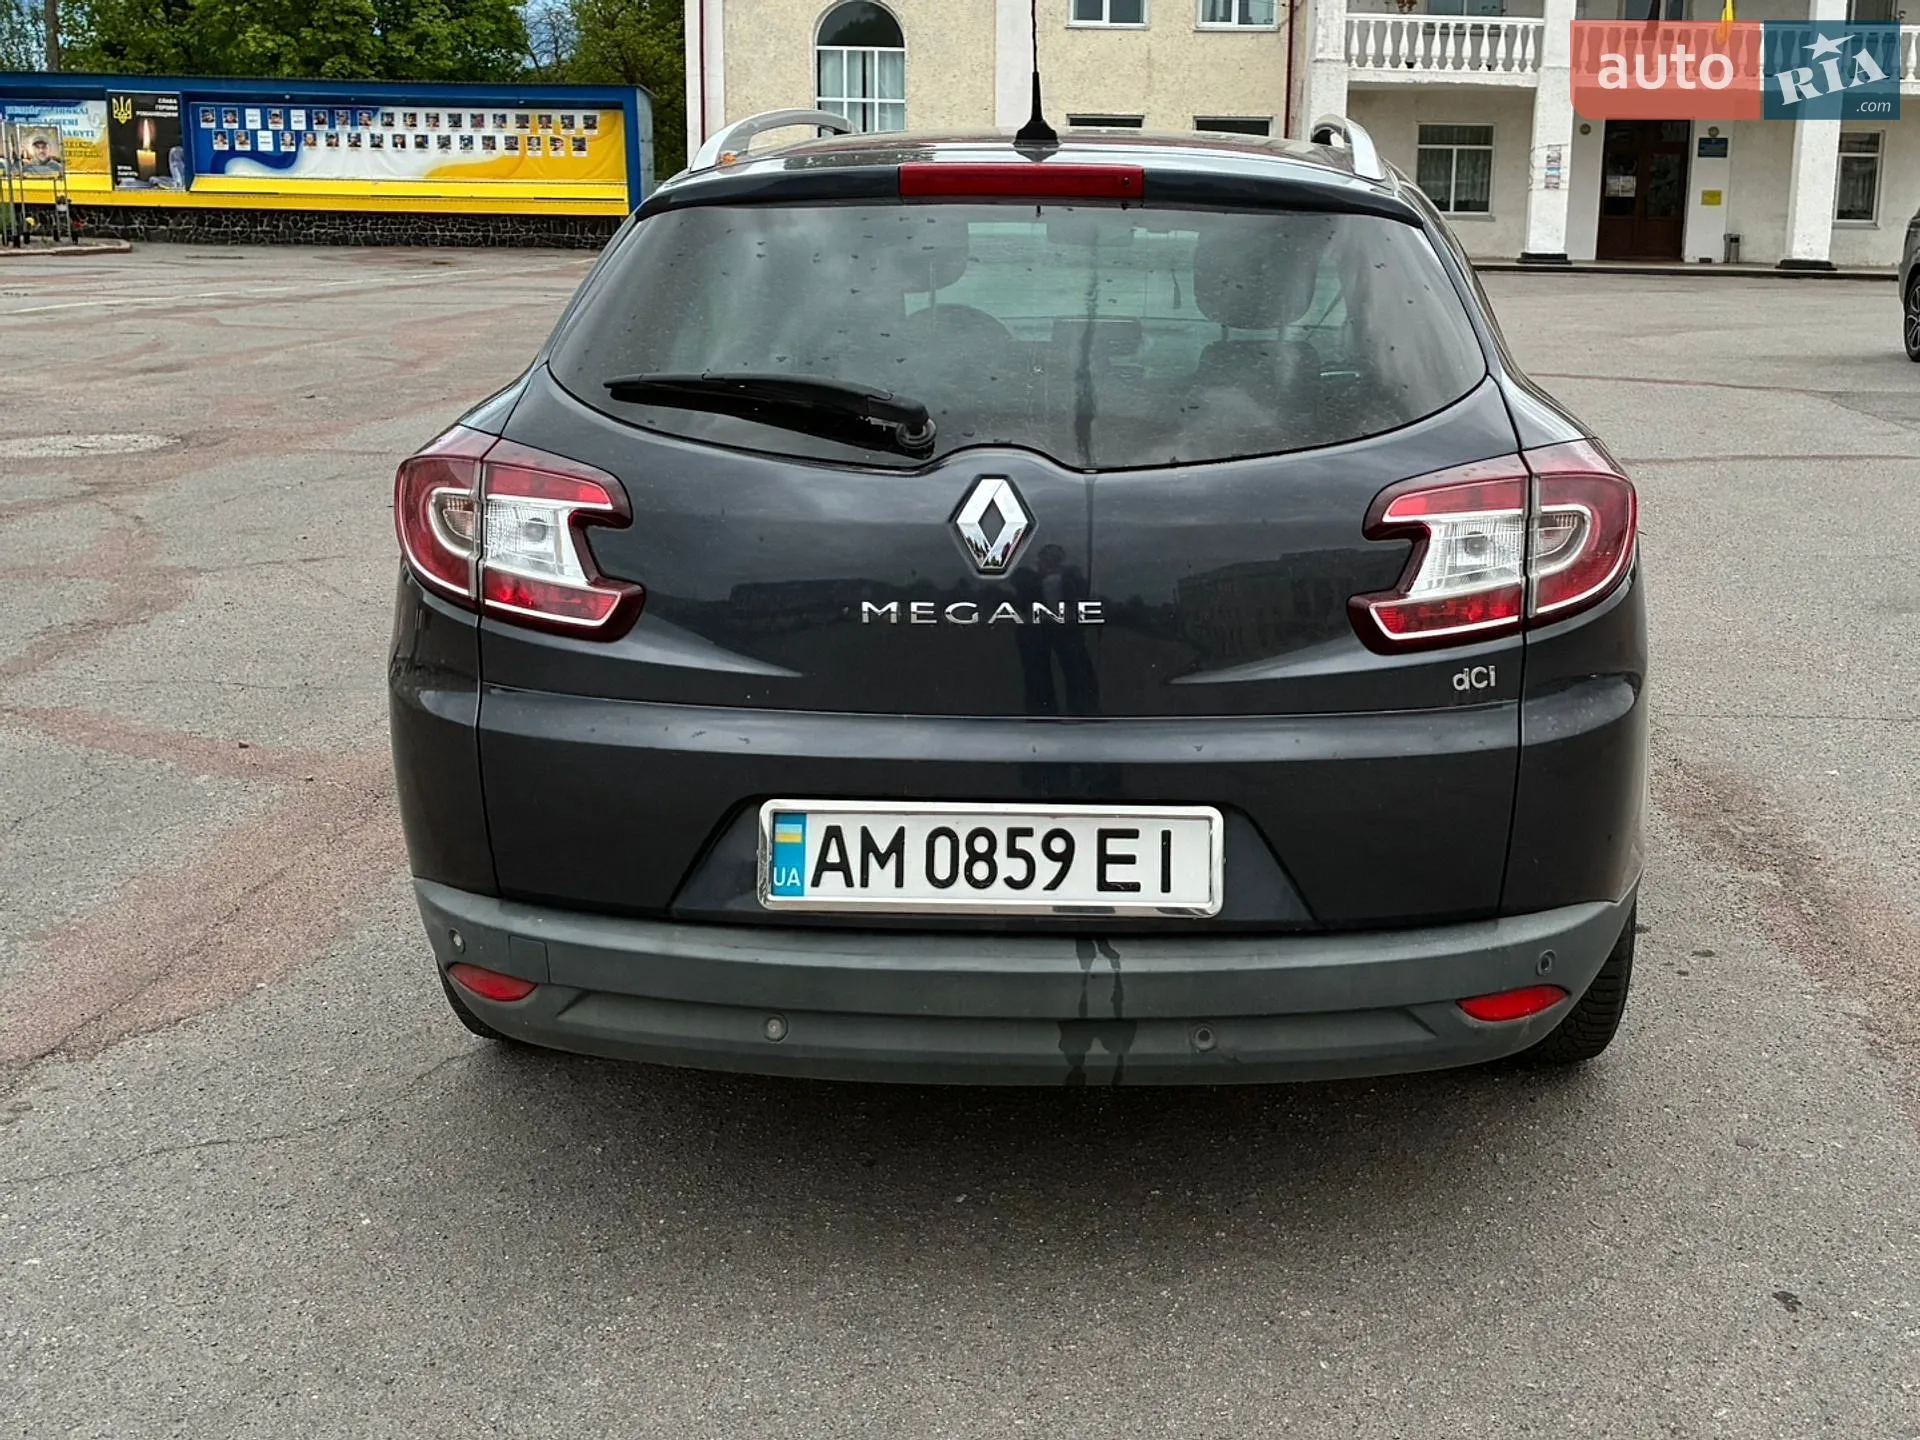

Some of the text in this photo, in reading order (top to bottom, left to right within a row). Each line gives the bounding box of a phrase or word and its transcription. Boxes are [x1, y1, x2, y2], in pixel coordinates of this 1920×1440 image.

[861, 601, 1105, 624] MEGANE
[810, 825, 1172, 893] AM 0859 EI
[773, 866, 801, 887] UA
